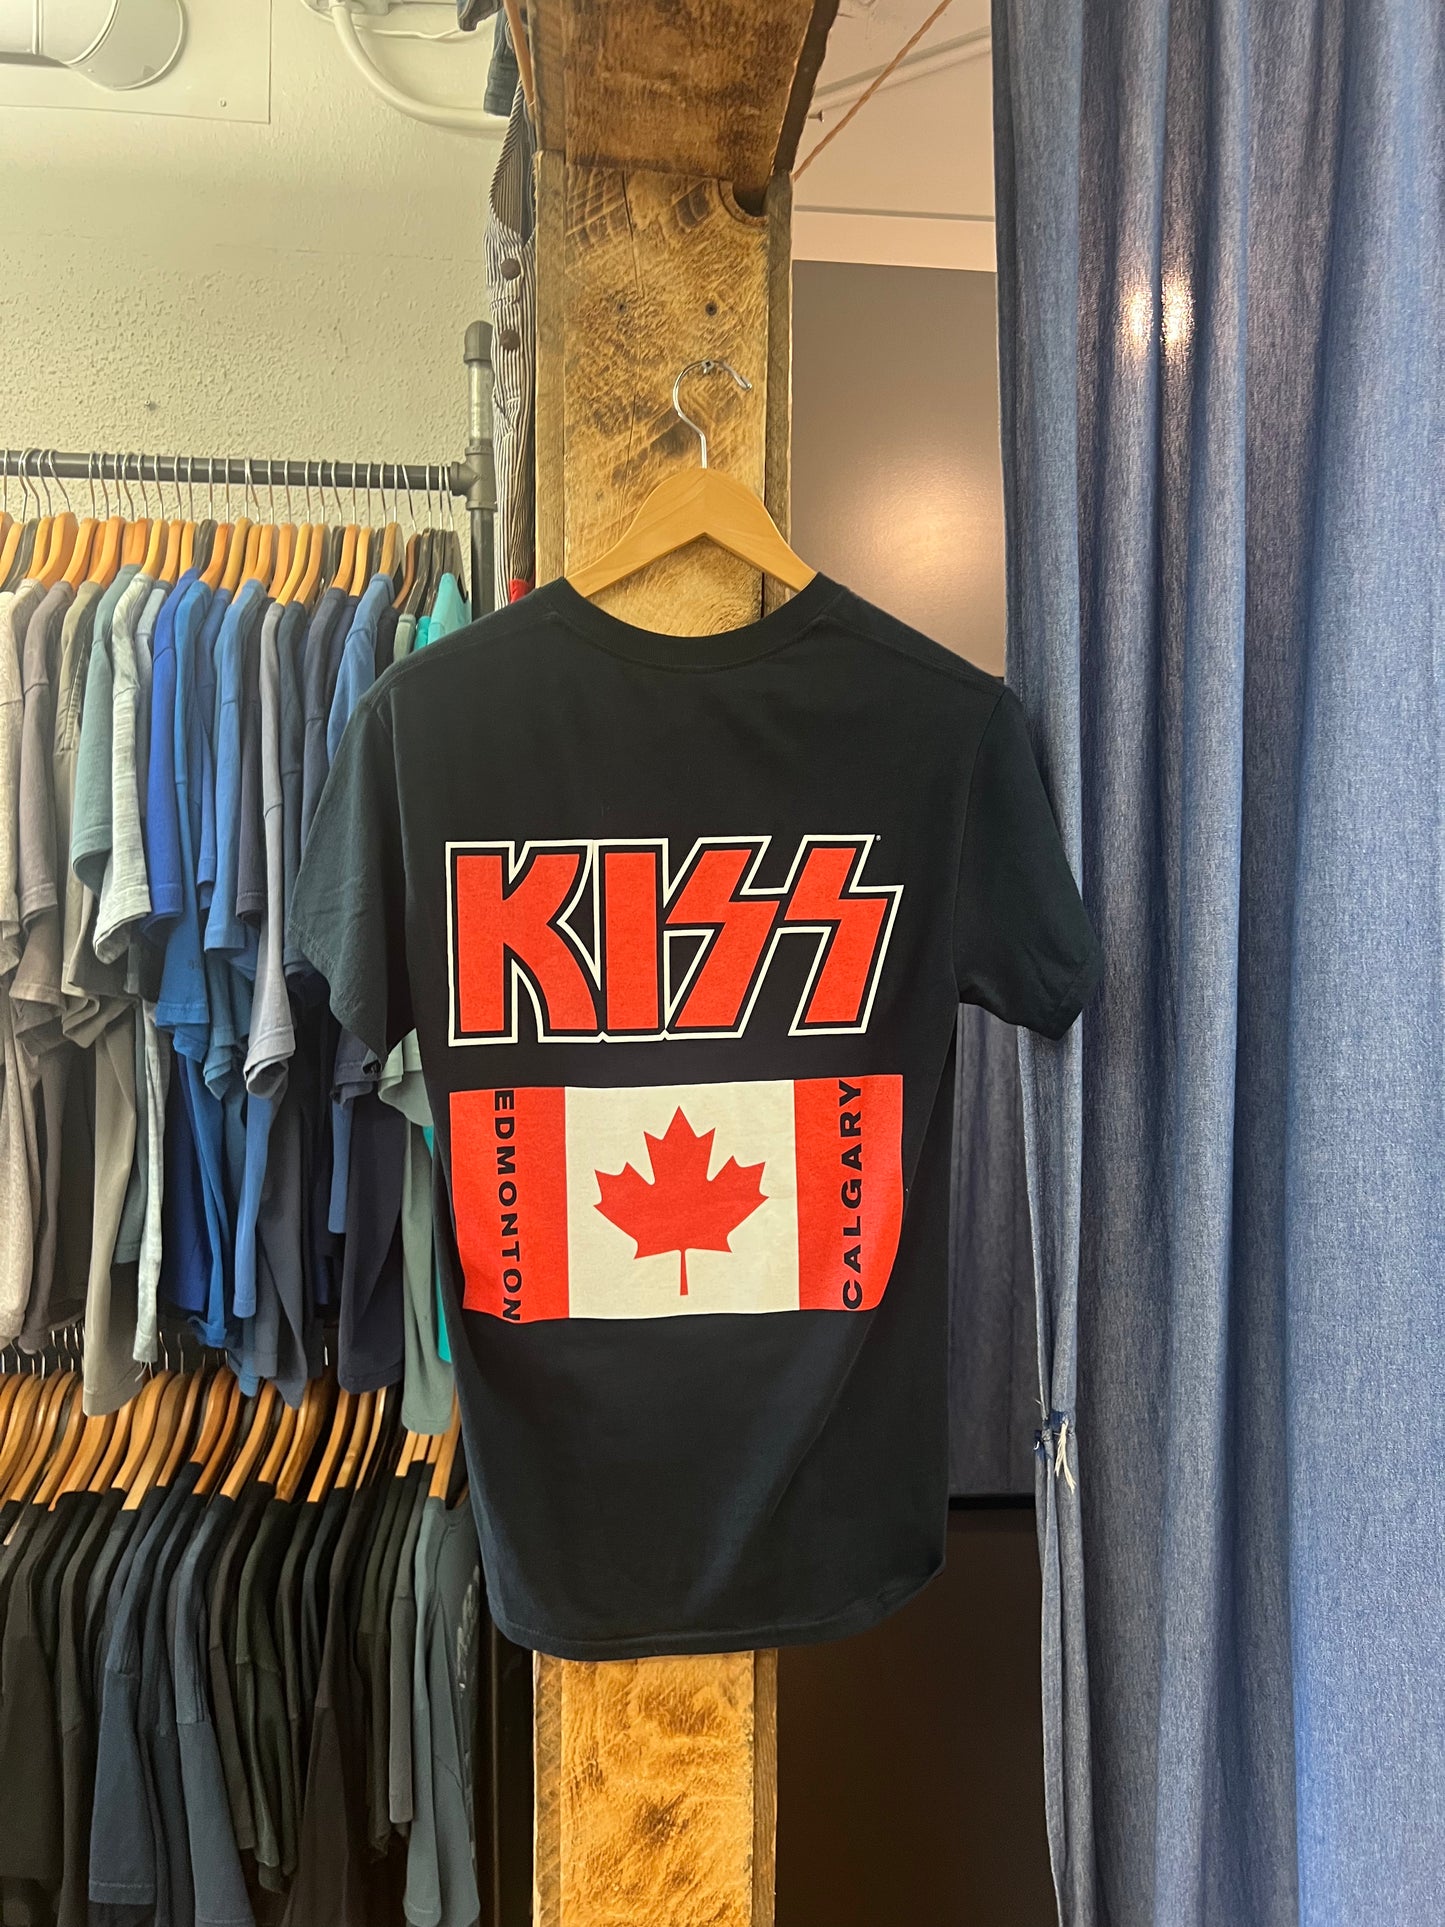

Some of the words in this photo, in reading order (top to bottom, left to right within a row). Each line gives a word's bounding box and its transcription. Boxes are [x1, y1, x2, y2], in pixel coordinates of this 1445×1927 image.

[445, 834, 904, 1047] KISS
[495, 1089, 521, 1321] EDMONTON
[839, 1079, 863, 1310] CALGARY
